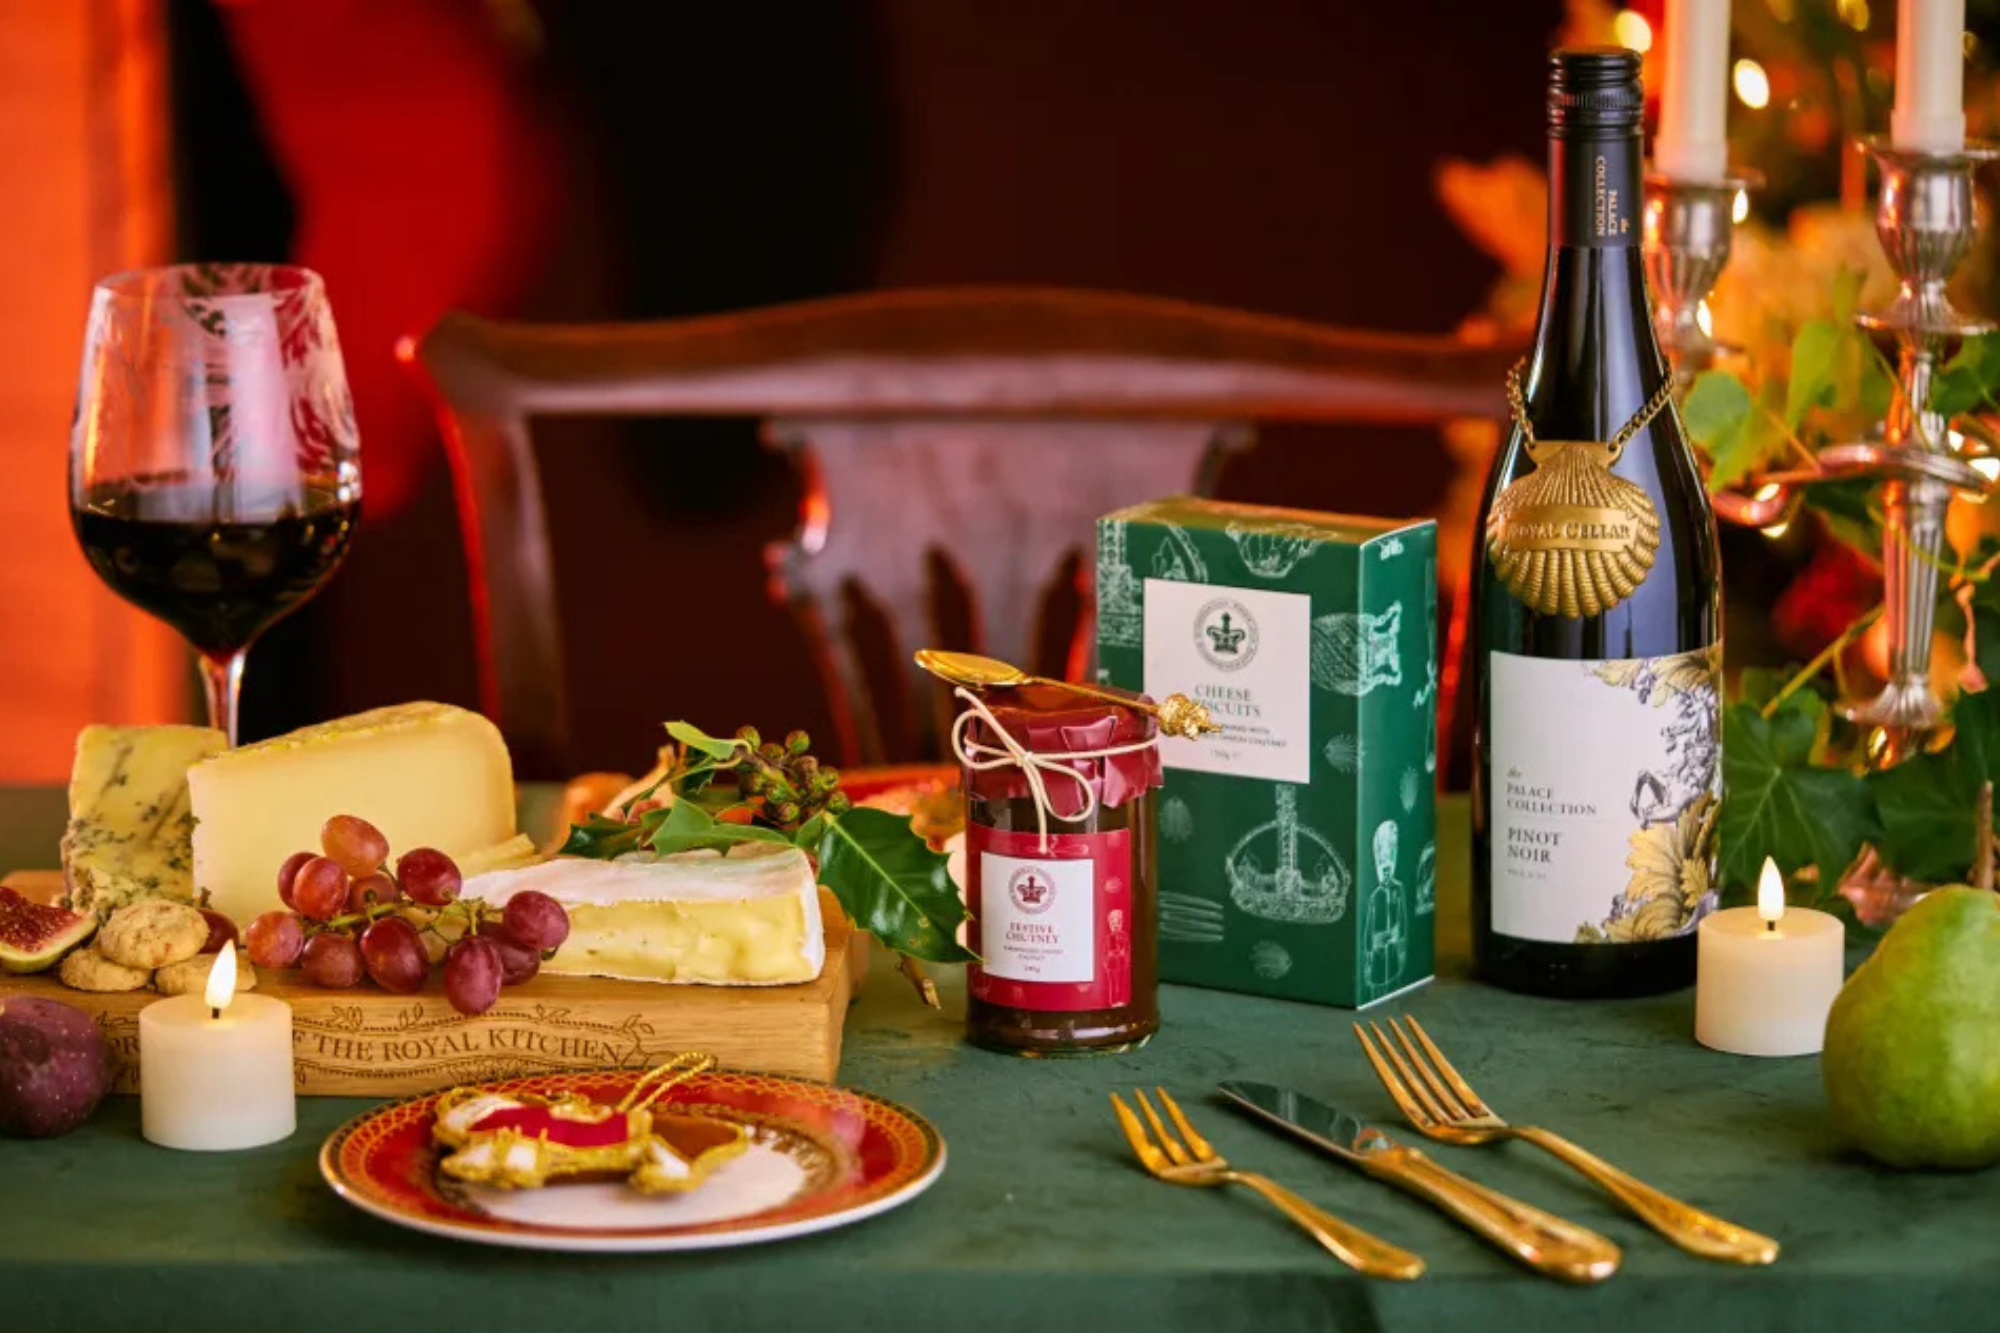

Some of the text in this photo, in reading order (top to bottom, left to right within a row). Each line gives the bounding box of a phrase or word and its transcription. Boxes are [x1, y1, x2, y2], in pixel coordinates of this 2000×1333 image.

[1595, 155, 1606, 237] COLLECTION
[1608, 189, 1618, 237] PALACE
[1508, 522, 1632, 541] ROYAL CELLAR
[1194, 684, 1252, 702] CHEESE
[1506, 782, 1552, 801] PALACE
[1506, 799, 1597, 816] COLLECTION
[1507, 826, 1561, 846] PINOT
[1507, 844, 1551, 863] NOIR
[1010, 921, 1054, 935] FESTIVE
[1005, 931, 1060, 945] CHUTNEY
[313, 1033, 374, 1062] THE
[382, 1031, 479, 1062] ROYAL
[487, 1028, 622, 1064] KITCHEN
